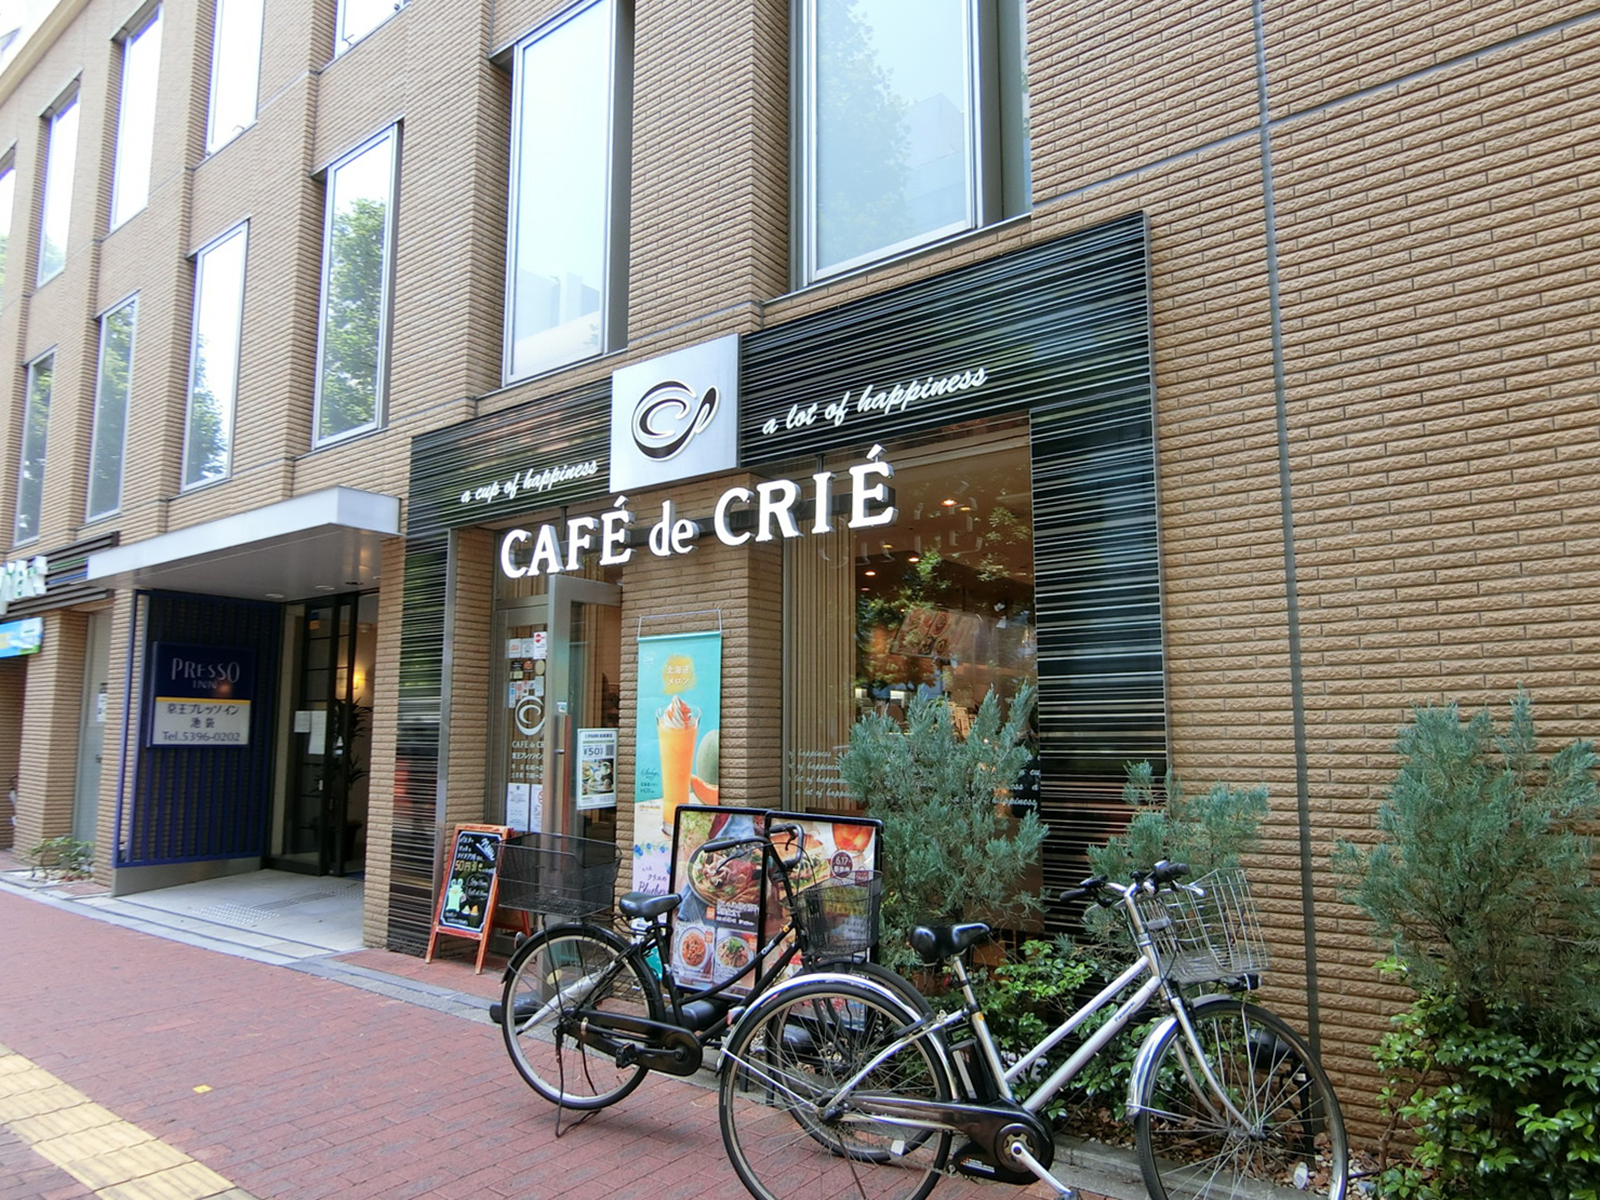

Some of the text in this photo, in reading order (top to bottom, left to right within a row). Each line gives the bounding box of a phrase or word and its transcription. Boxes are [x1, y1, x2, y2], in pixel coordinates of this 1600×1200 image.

[762, 366, 988, 435] a lot of happiness
[460, 459, 598, 504] a cup of happiness
[500, 444, 898, 579] CAFÉ de CRIÉ
[171, 656, 241, 684] PRESSO
[666, 665, 689, 675] 北海道
[192, 680, 218, 690] INN
[666, 677, 689, 686] メロン
[166, 703, 240, 717] 京王プレッソイン
